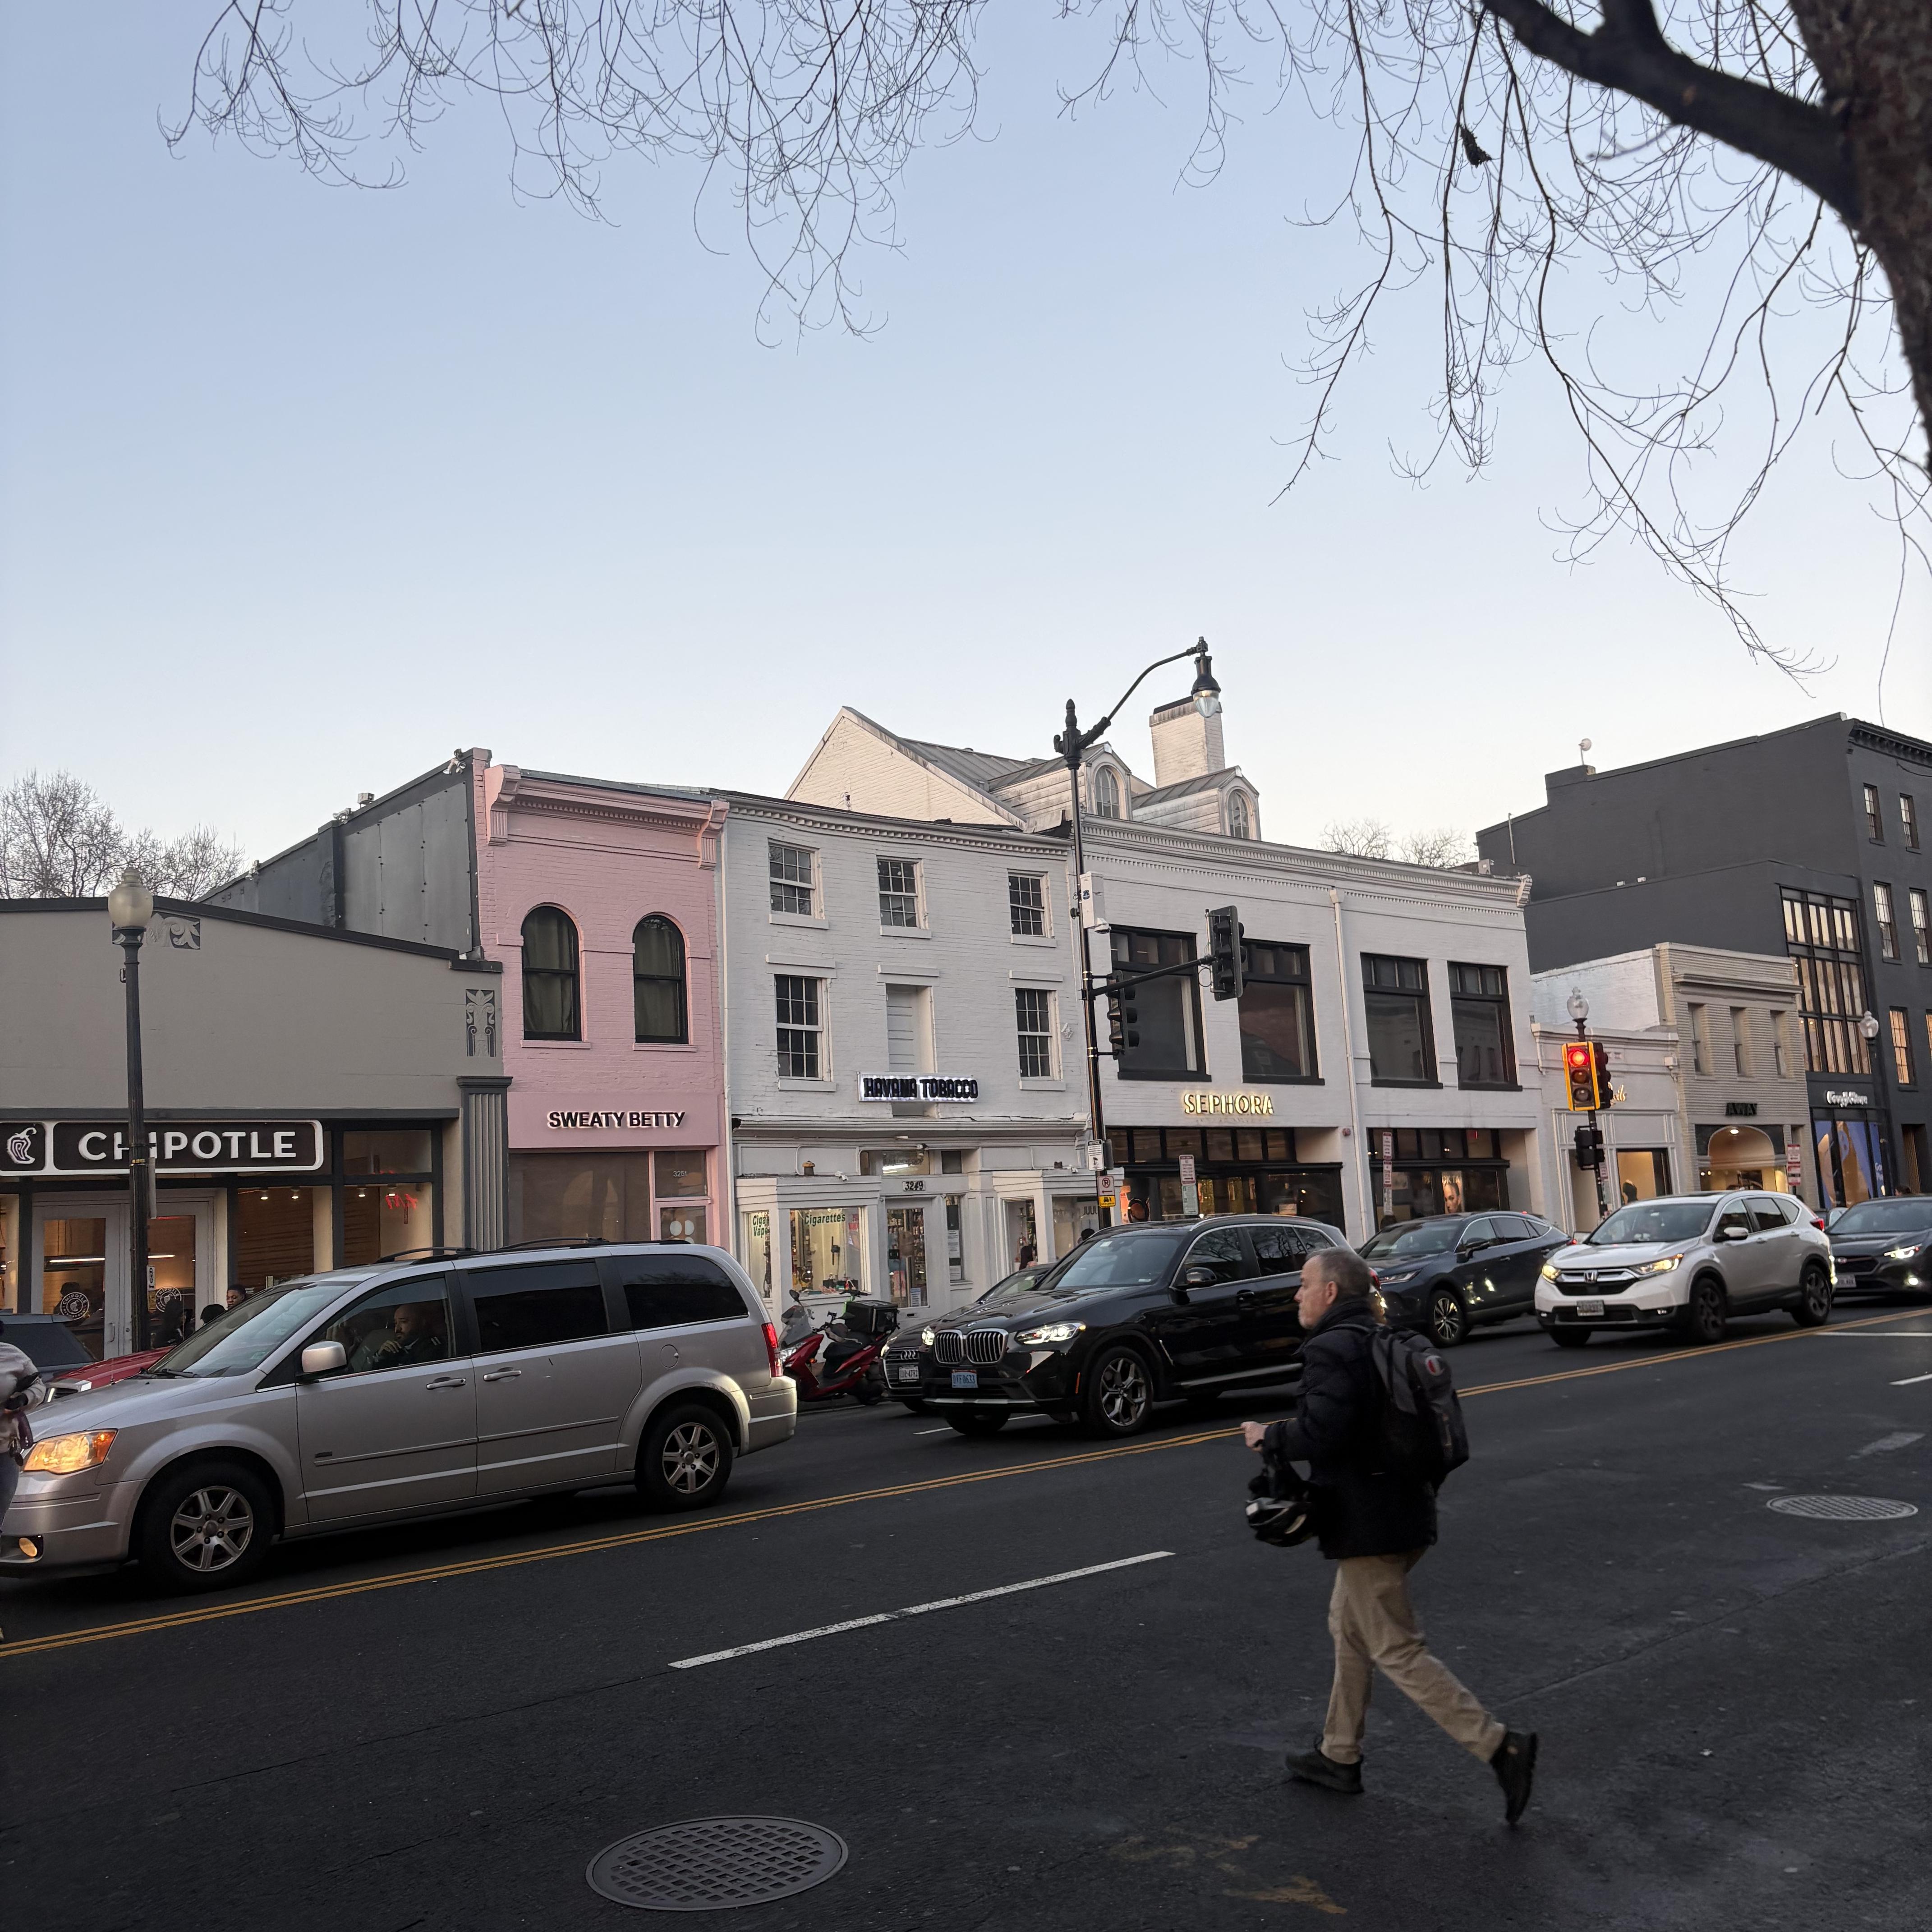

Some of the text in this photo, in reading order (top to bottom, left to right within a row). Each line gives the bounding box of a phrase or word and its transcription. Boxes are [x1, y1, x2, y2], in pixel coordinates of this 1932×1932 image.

[863, 1078, 978, 1099] HAVANA TOBACCO
[1184, 1094, 1274, 1114] SEPHORA
[549, 1112, 685, 1127] SWEATY BETTY
[78, 1131, 296, 1160] CHIPOTLE
[905, 1181, 923, 1191] 3249
[805, 1214, 846, 1227] Cigarettes
